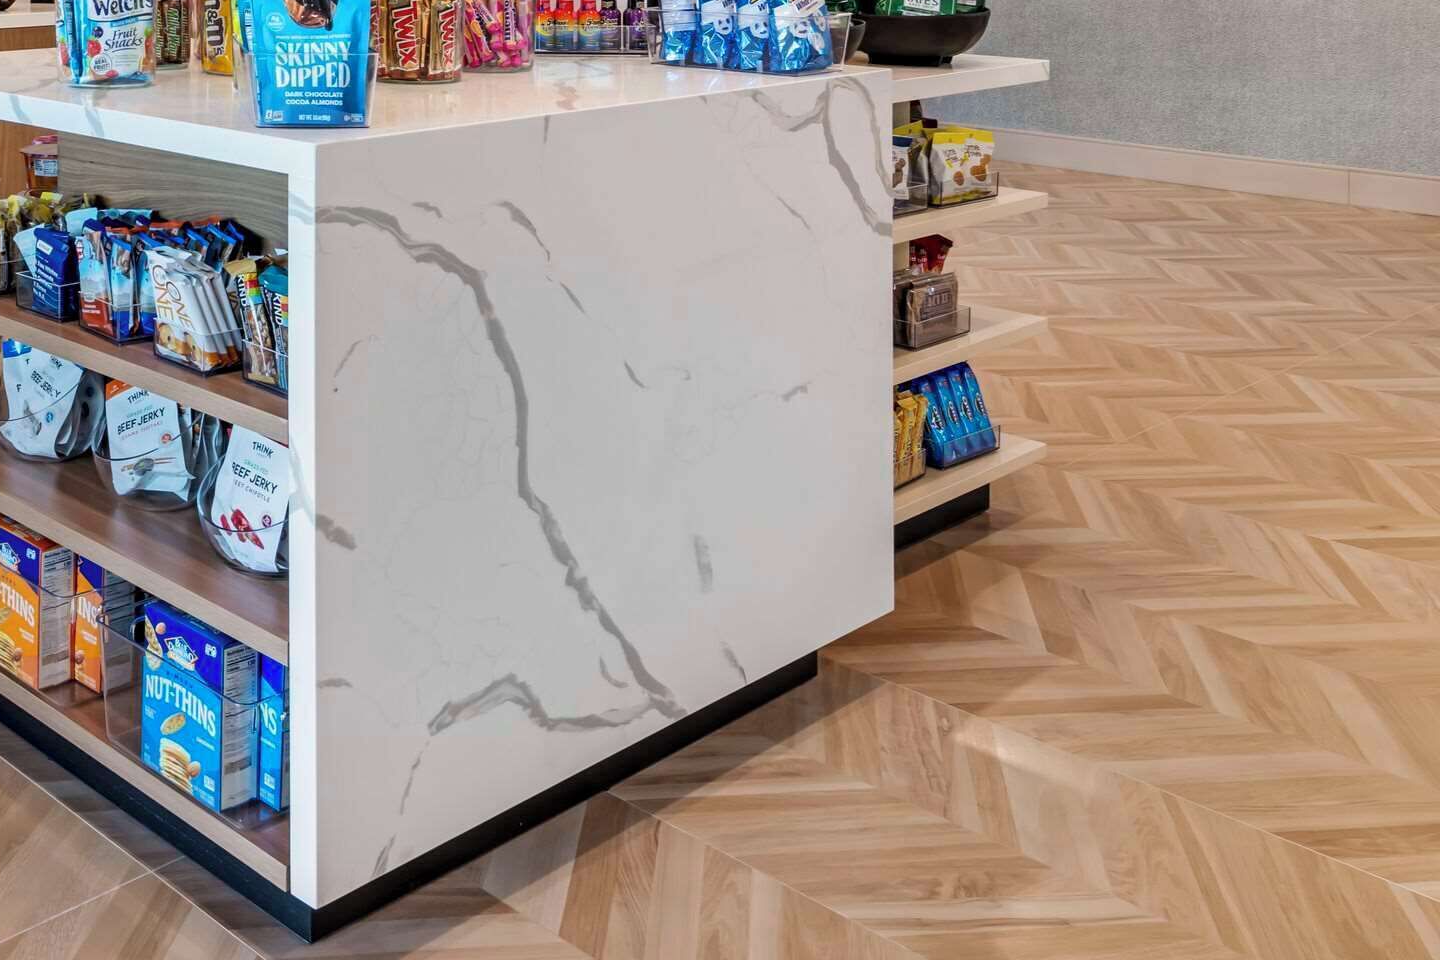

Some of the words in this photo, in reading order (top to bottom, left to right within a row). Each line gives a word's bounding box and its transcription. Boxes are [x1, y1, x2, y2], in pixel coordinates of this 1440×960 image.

[104, 36, 143, 50] Snacks
[112, 26, 138, 41] Fruit
[274, 41, 352, 66] SKINNY
[276, 61, 351, 89] DIPPED
[285, 98, 310, 106] COCOA
[311, 99, 344, 107] ALMONDS
[304, 91, 344, 99] CHOCOLATE
[237, 273, 250, 310] KIND
[273, 292, 284, 326] KIND
[127, 390, 150, 404] THINK
[117, 418, 136, 435] BEEF
[137, 407, 166, 426] JERKY
[252, 441, 274, 459] THINK
[249, 474, 278, 495] JERKY
[145, 674, 217, 737] NUT-THINS
